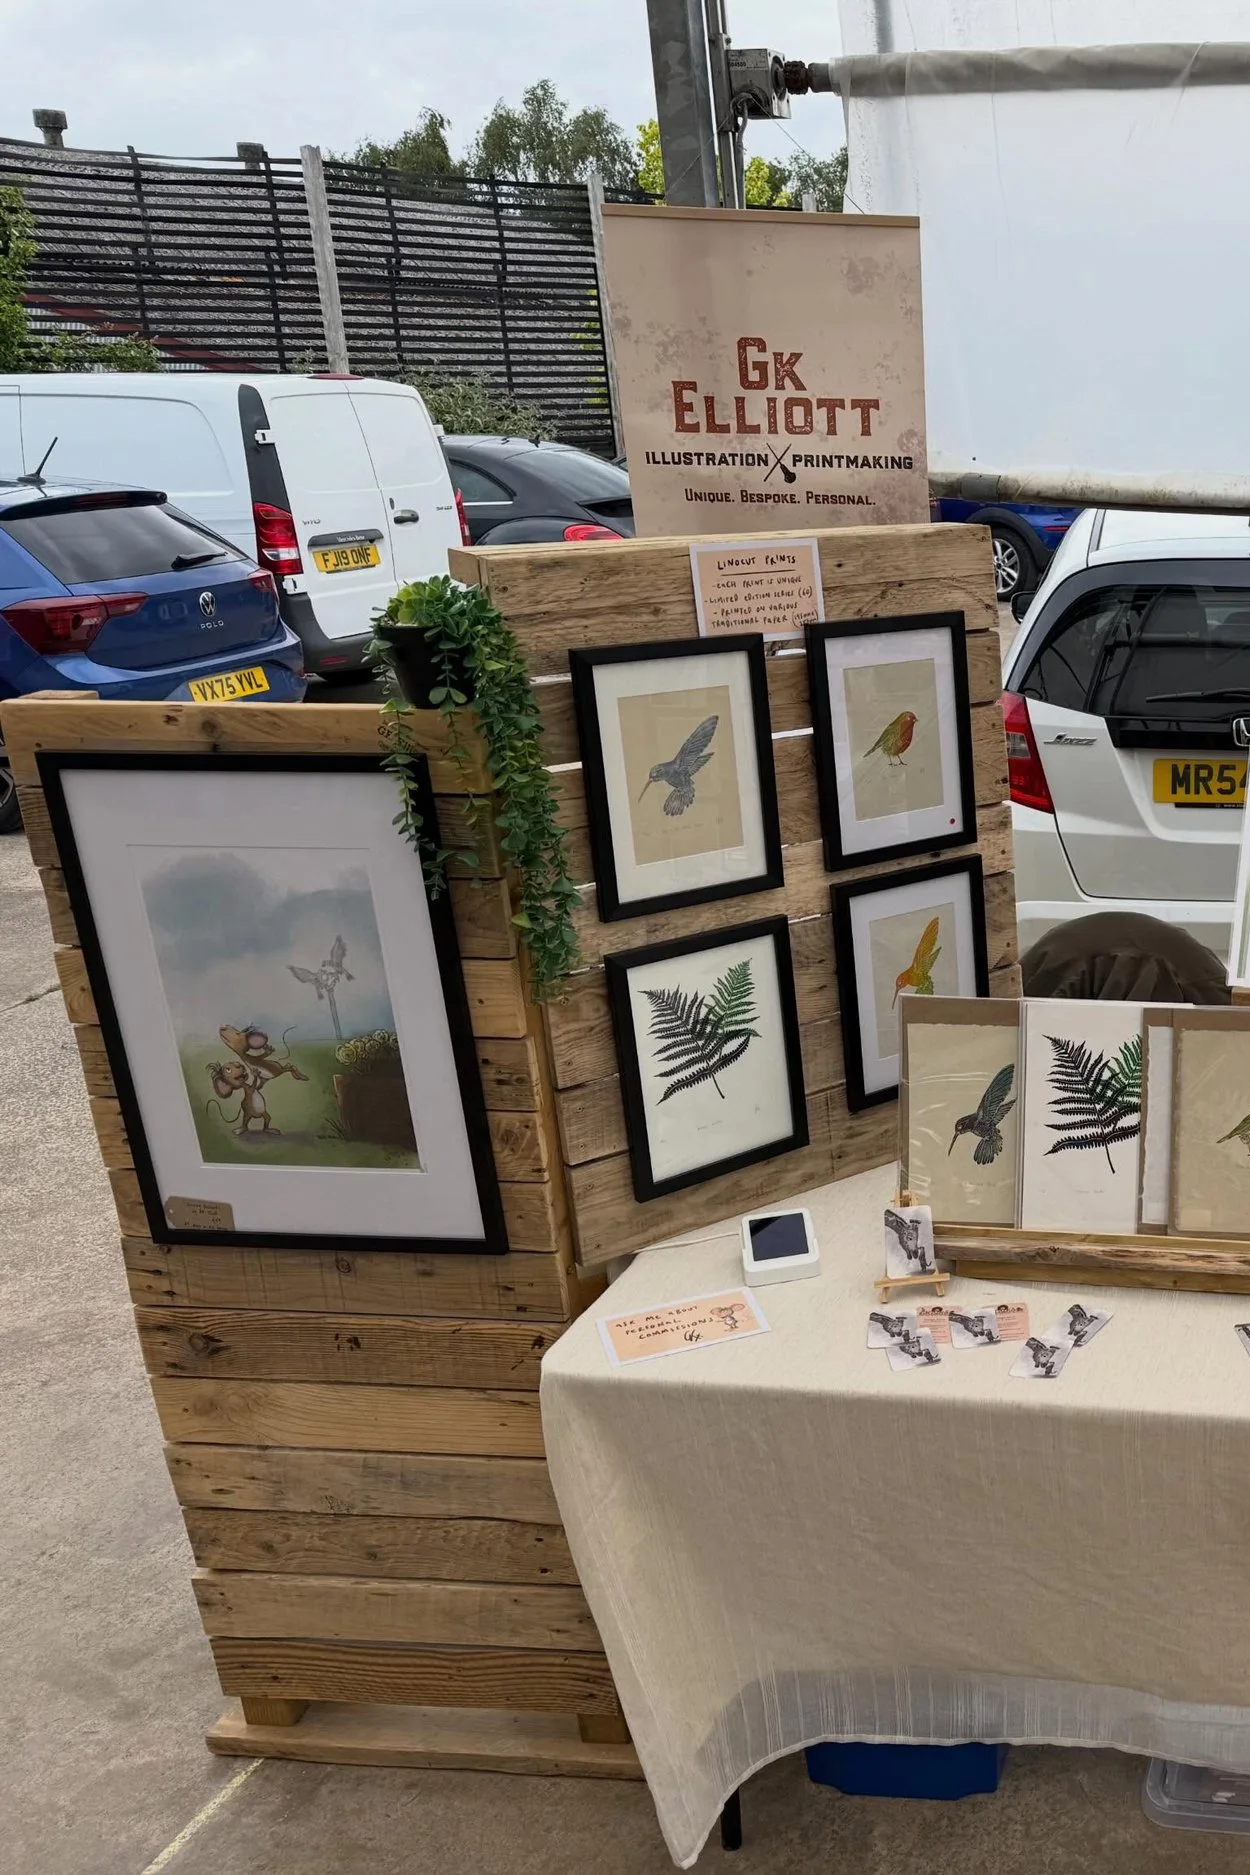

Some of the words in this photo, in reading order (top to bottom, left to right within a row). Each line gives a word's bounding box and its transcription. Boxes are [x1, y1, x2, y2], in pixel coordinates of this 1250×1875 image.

[672, 381, 880, 436] ELLIOTT
[646, 451, 769, 467] ILLUSTRATION
[792, 454, 913, 470] PRINTMAKING
[684, 488, 735, 503] UNIQUE.
[740, 490, 800, 504] BESPOKE.
[806, 491, 876, 505] PERSONAL.
[718, 557, 756, 570] LINOCUT
[765, 555, 796, 565] PRINTS
[743, 579, 764, 589] PRINT
[777, 576, 802, 585] UNIQUE
[710, 594, 739, 604] LIMITED
[744, 592, 771, 602] EDITION
[774, 590, 794, 598] SERIES
[721, 608, 752, 617] PRINTED
[769, 602, 798, 611] VARIOUS
[712, 616, 759, 629] TRADITIONAL
[763, 615, 788, 625] PAPER
[196, 676, 236, 701] VX75
[235, 671, 263, 692] YVL
[668, 1305, 698, 1316] ABOUT
[625, 1319, 681, 1335] PERSONAL
[639, 1317, 714, 1340] COMMISSIONS
